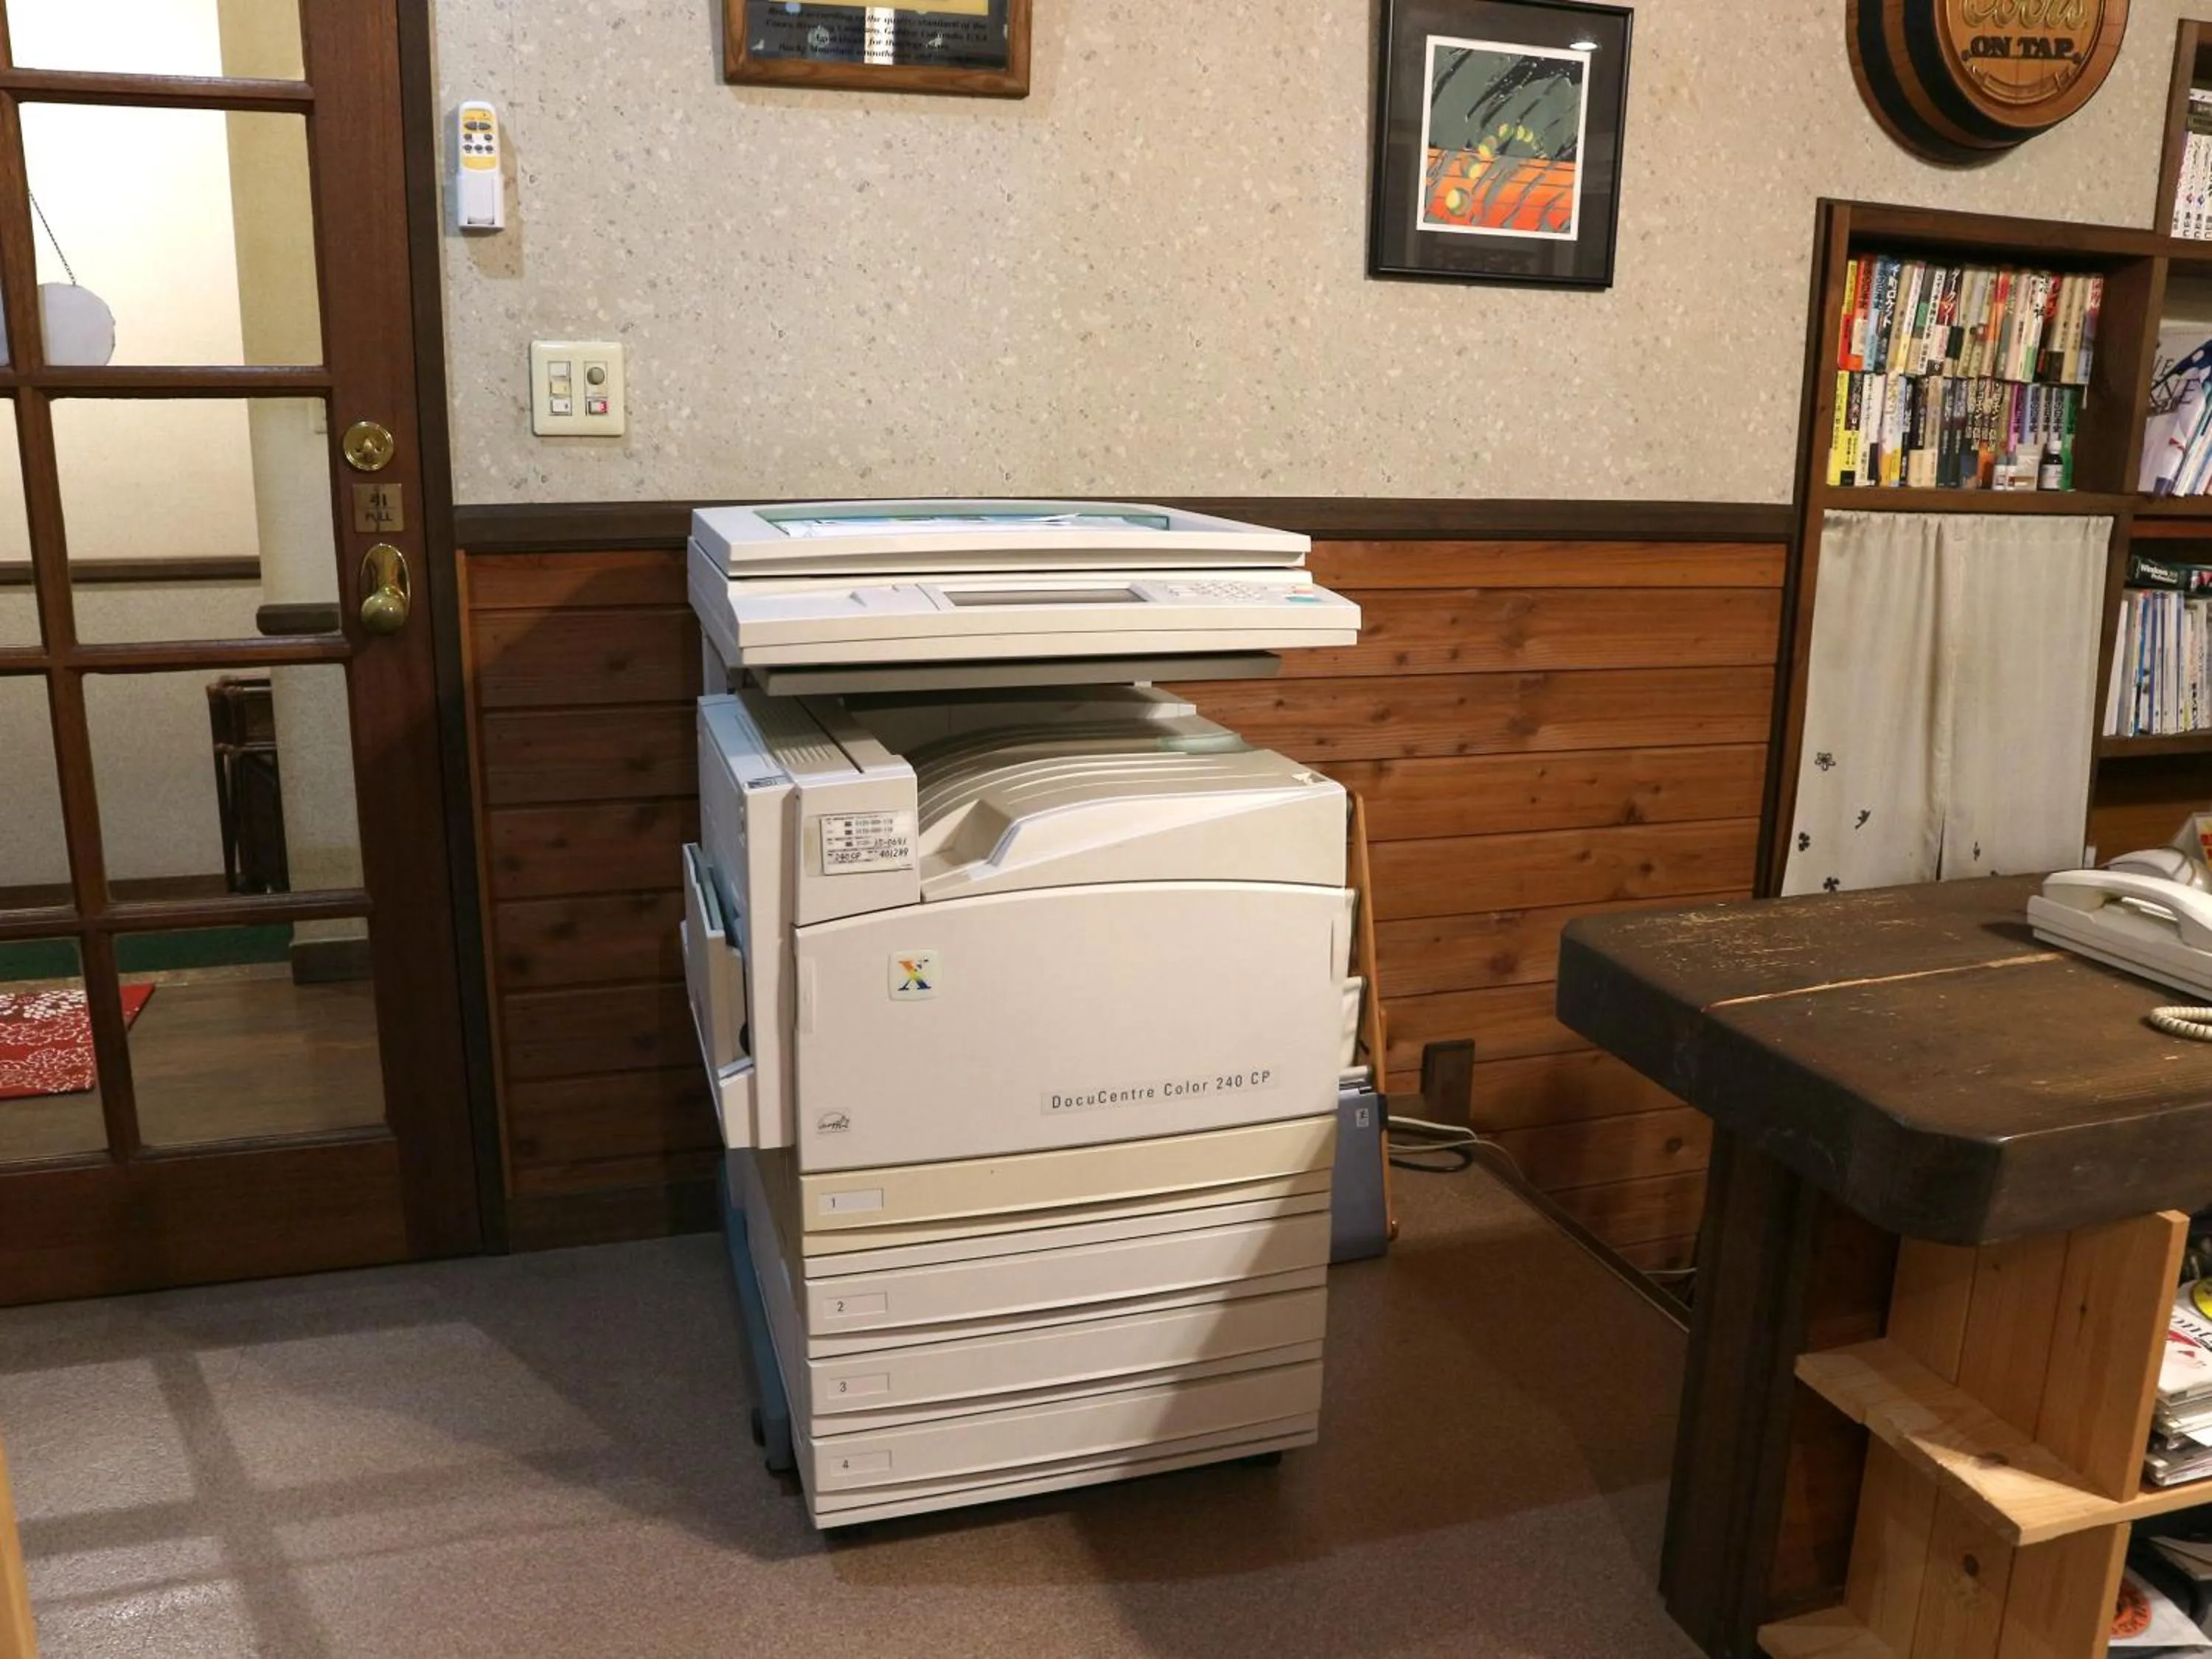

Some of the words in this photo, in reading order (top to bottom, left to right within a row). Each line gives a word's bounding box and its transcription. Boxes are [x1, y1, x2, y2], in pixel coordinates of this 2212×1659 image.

[1970, 35, 2011, 58] ON
[2017, 38, 2075, 60] TAP
[1051, 1089, 1155, 1109] DocuCentre
[1164, 1081, 1208, 1096] Color
[1216, 1074, 1243, 1090] 240
[1251, 1070, 1271, 1085] CP
[831, 1197, 835, 1208] 1
[837, 1301, 844, 1312] 2
[839, 1381, 847, 1393] 3
[842, 1459, 849, 1470] 4
